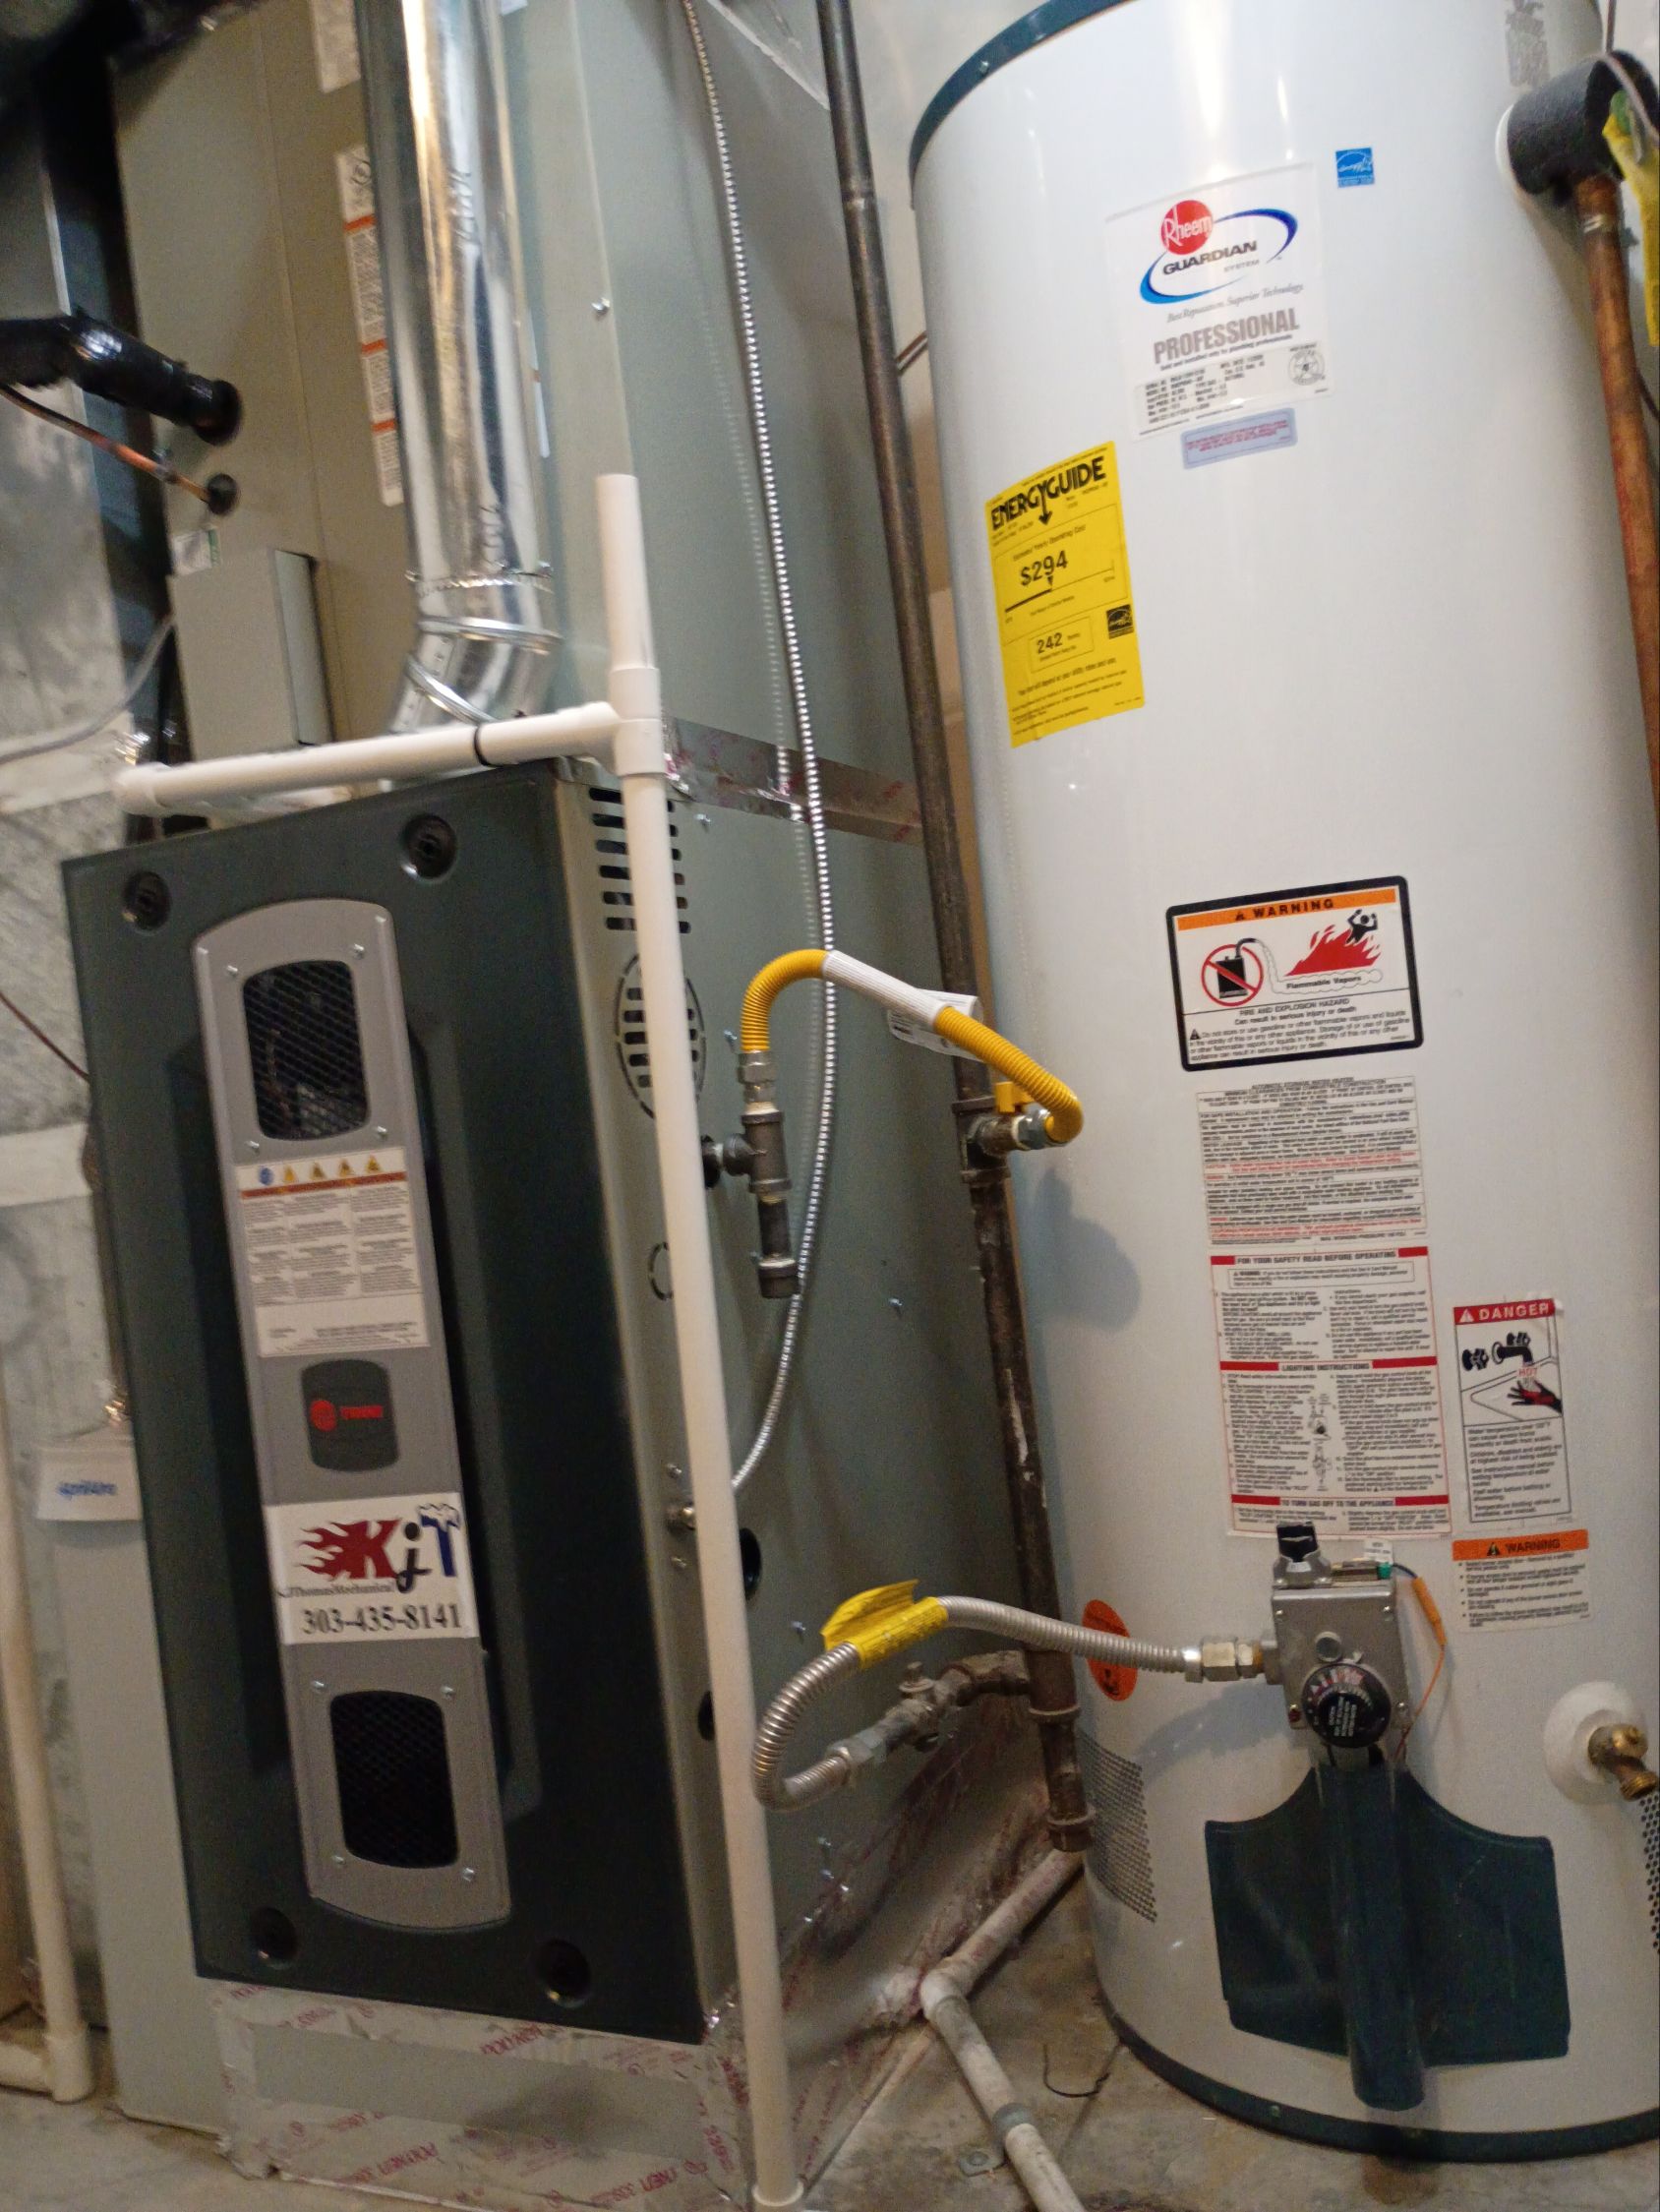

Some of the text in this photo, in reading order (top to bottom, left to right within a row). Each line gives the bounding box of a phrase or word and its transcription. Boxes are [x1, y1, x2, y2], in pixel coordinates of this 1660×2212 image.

[1163, 204, 1213, 247] Rheem
[1162, 240, 1258, 275] GUARDIAN
[1154, 307, 1300, 365] PROFESSIONAL
[990, 455, 1107, 531] ENERGYGUIDE
[1020, 550, 1068, 586] $294
[1036, 632, 1063, 654] 242
[1253, 898, 1334, 918] WARNING
[1285, 976, 1362, 989] Flammable Vapors
[1478, 1302, 1550, 1320] DANGER
[1518, 1367, 1538, 1376] HOT
[1505, 1538, 1562, 1554] WARNING
[302, 1603, 462, 1635] 303-435-8141
